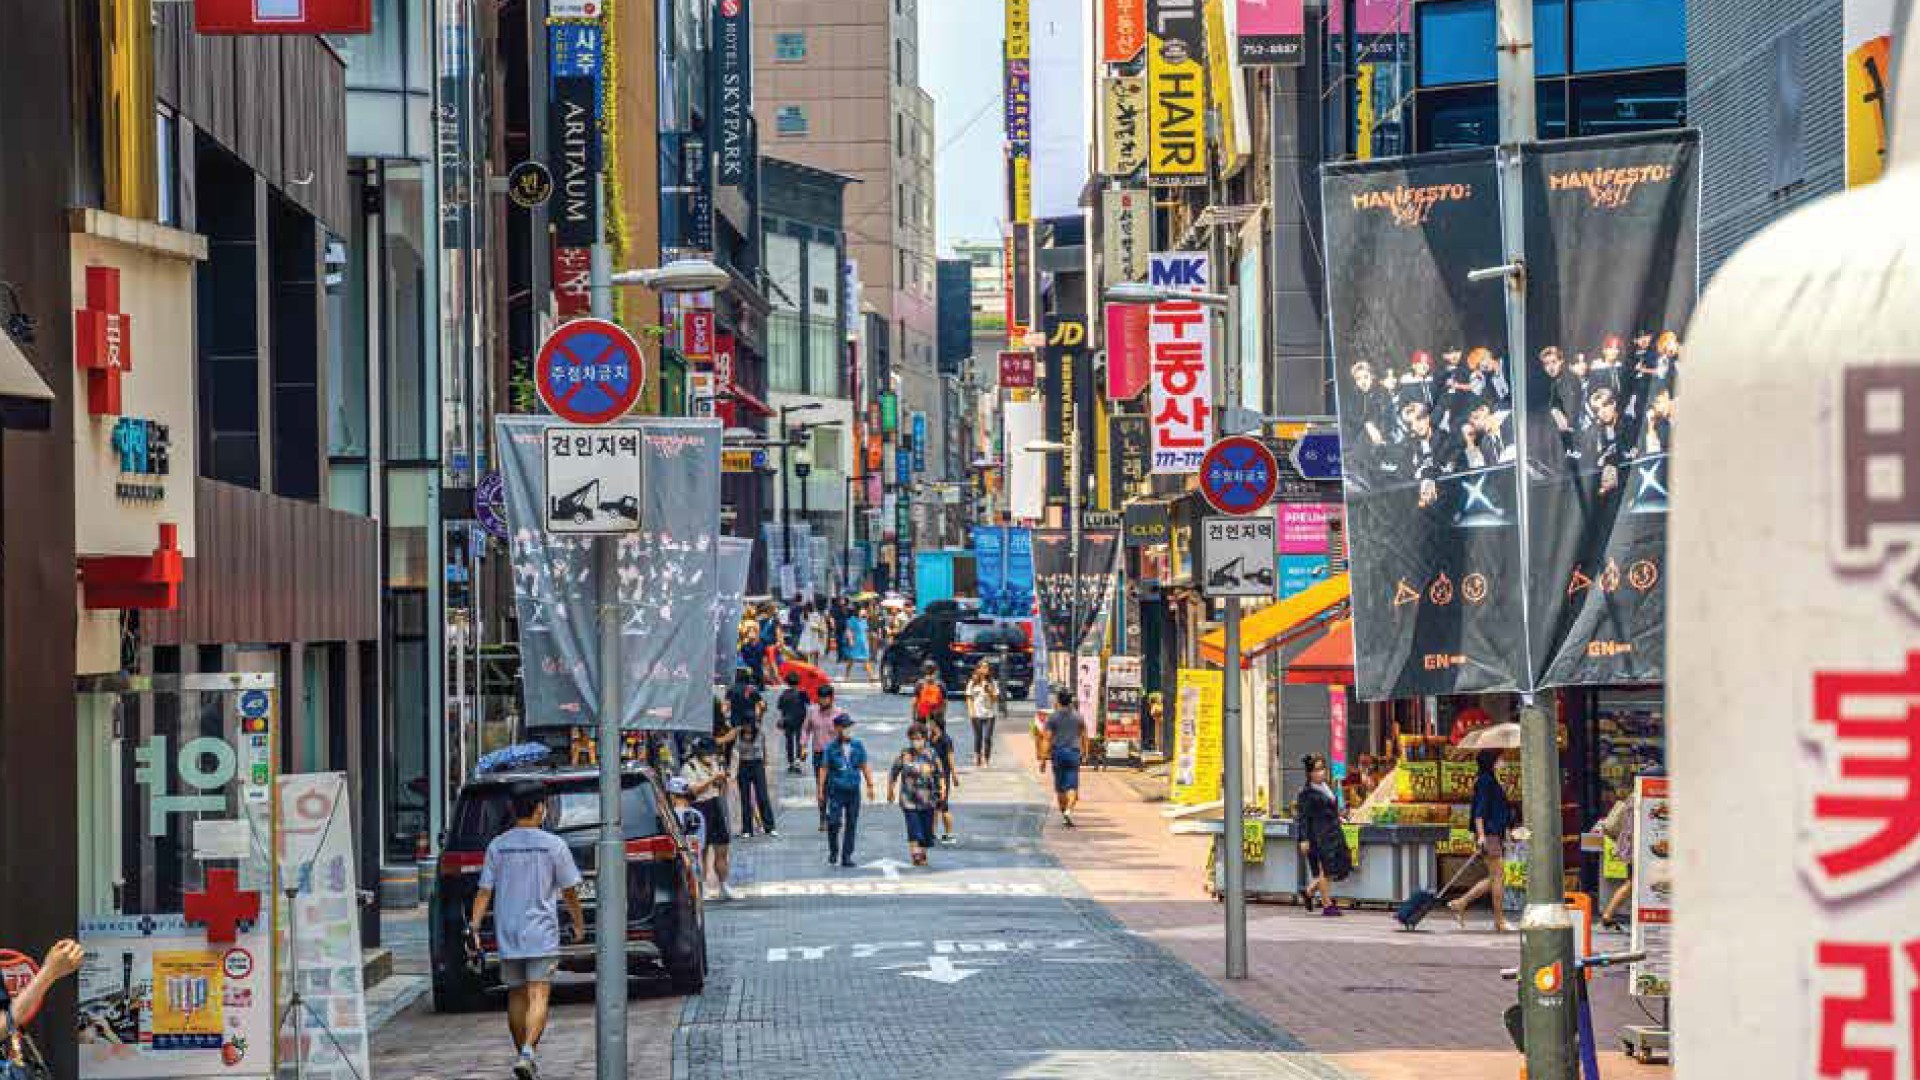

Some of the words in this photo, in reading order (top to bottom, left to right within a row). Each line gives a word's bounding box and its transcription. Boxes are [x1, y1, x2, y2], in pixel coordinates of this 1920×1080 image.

[723, 73, 741, 175] SKYPARK
[1158, 73, 1196, 167] HAIR
[564, 100, 588, 222] ARITAUM
[1152, 258, 1207, 285] MK
[1049, 321, 1085, 346] JD
[551, 363, 629, 382] 주정차금지
[551, 435, 637, 457] 견인지역
[1209, 523, 1273, 541] 견인지역
